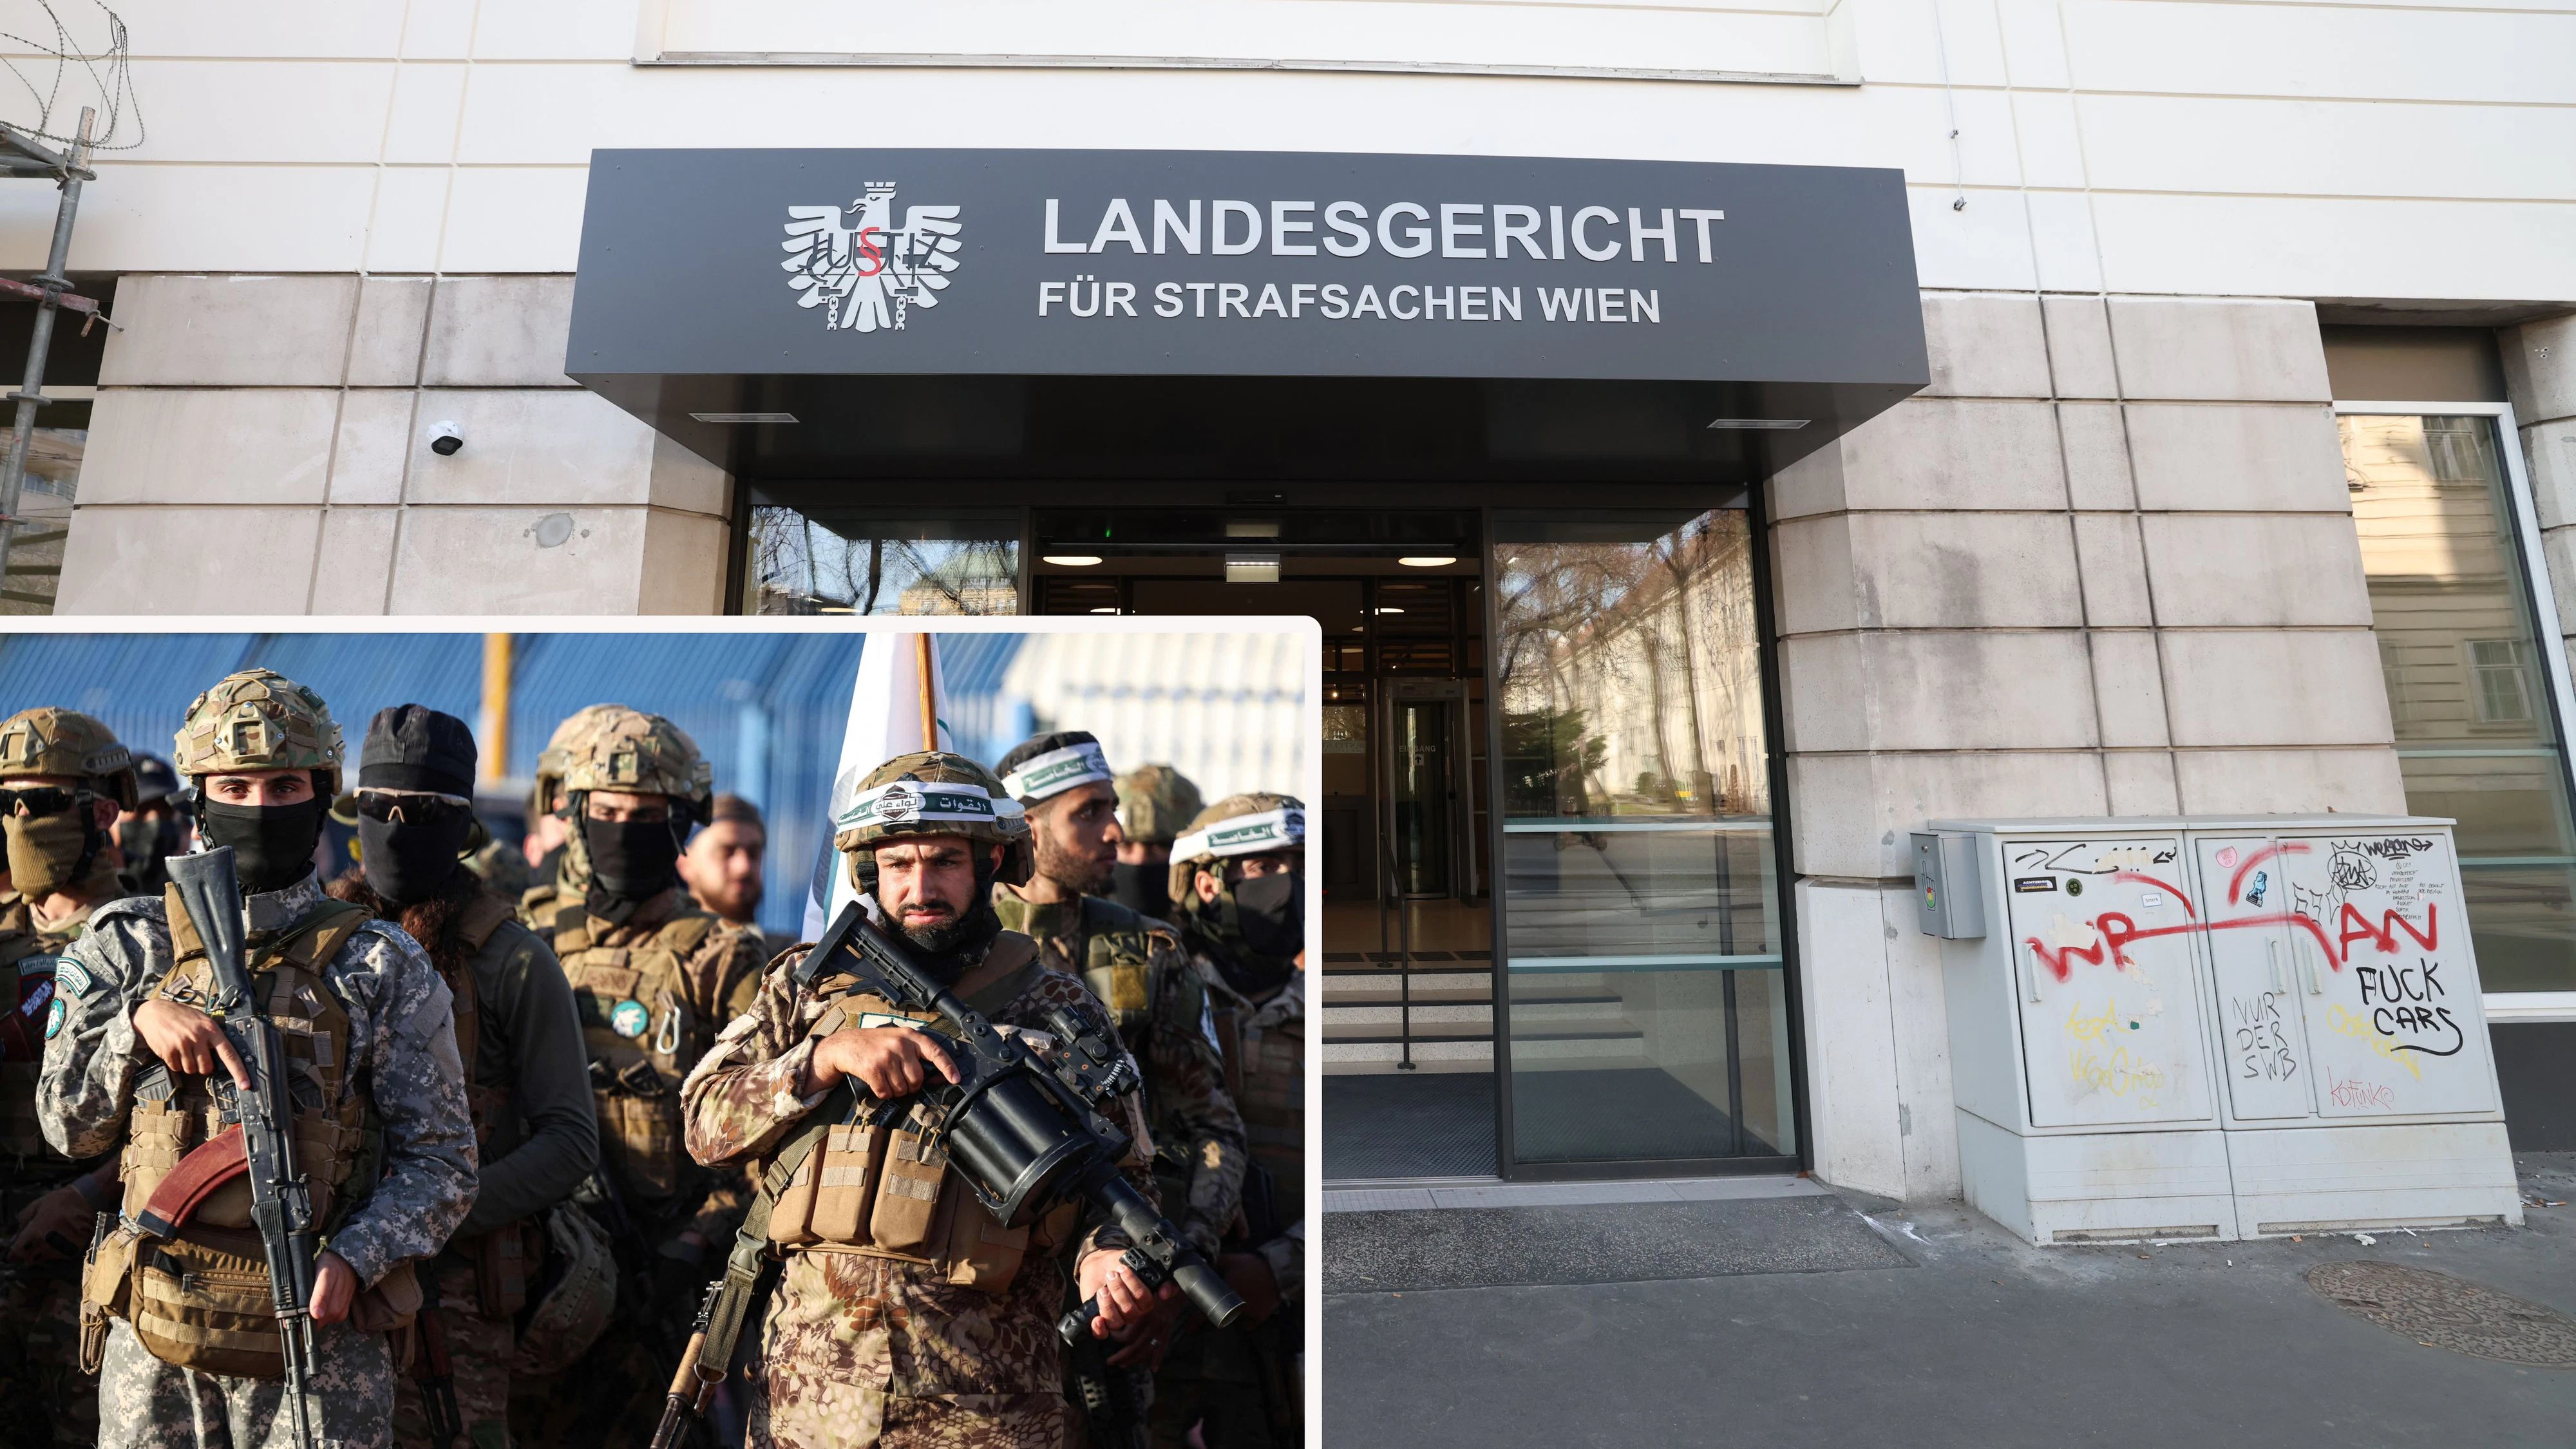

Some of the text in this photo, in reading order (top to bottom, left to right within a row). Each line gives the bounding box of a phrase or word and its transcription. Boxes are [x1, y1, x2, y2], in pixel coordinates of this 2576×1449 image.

[1044, 198, 1725, 263] LANDESGERICHT
[1038, 274, 1661, 324] FÜR STRAFSACHEN WIEN
[940, 797, 987, 812] القوات
[2356, 958, 2445, 1005] FUCK
[2231, 992, 2280, 1025] NUR
[2236, 1021, 2288, 1052] DER
[2374, 1006, 2464, 1056] CARS
[2243, 1047, 2297, 1082] SWB
